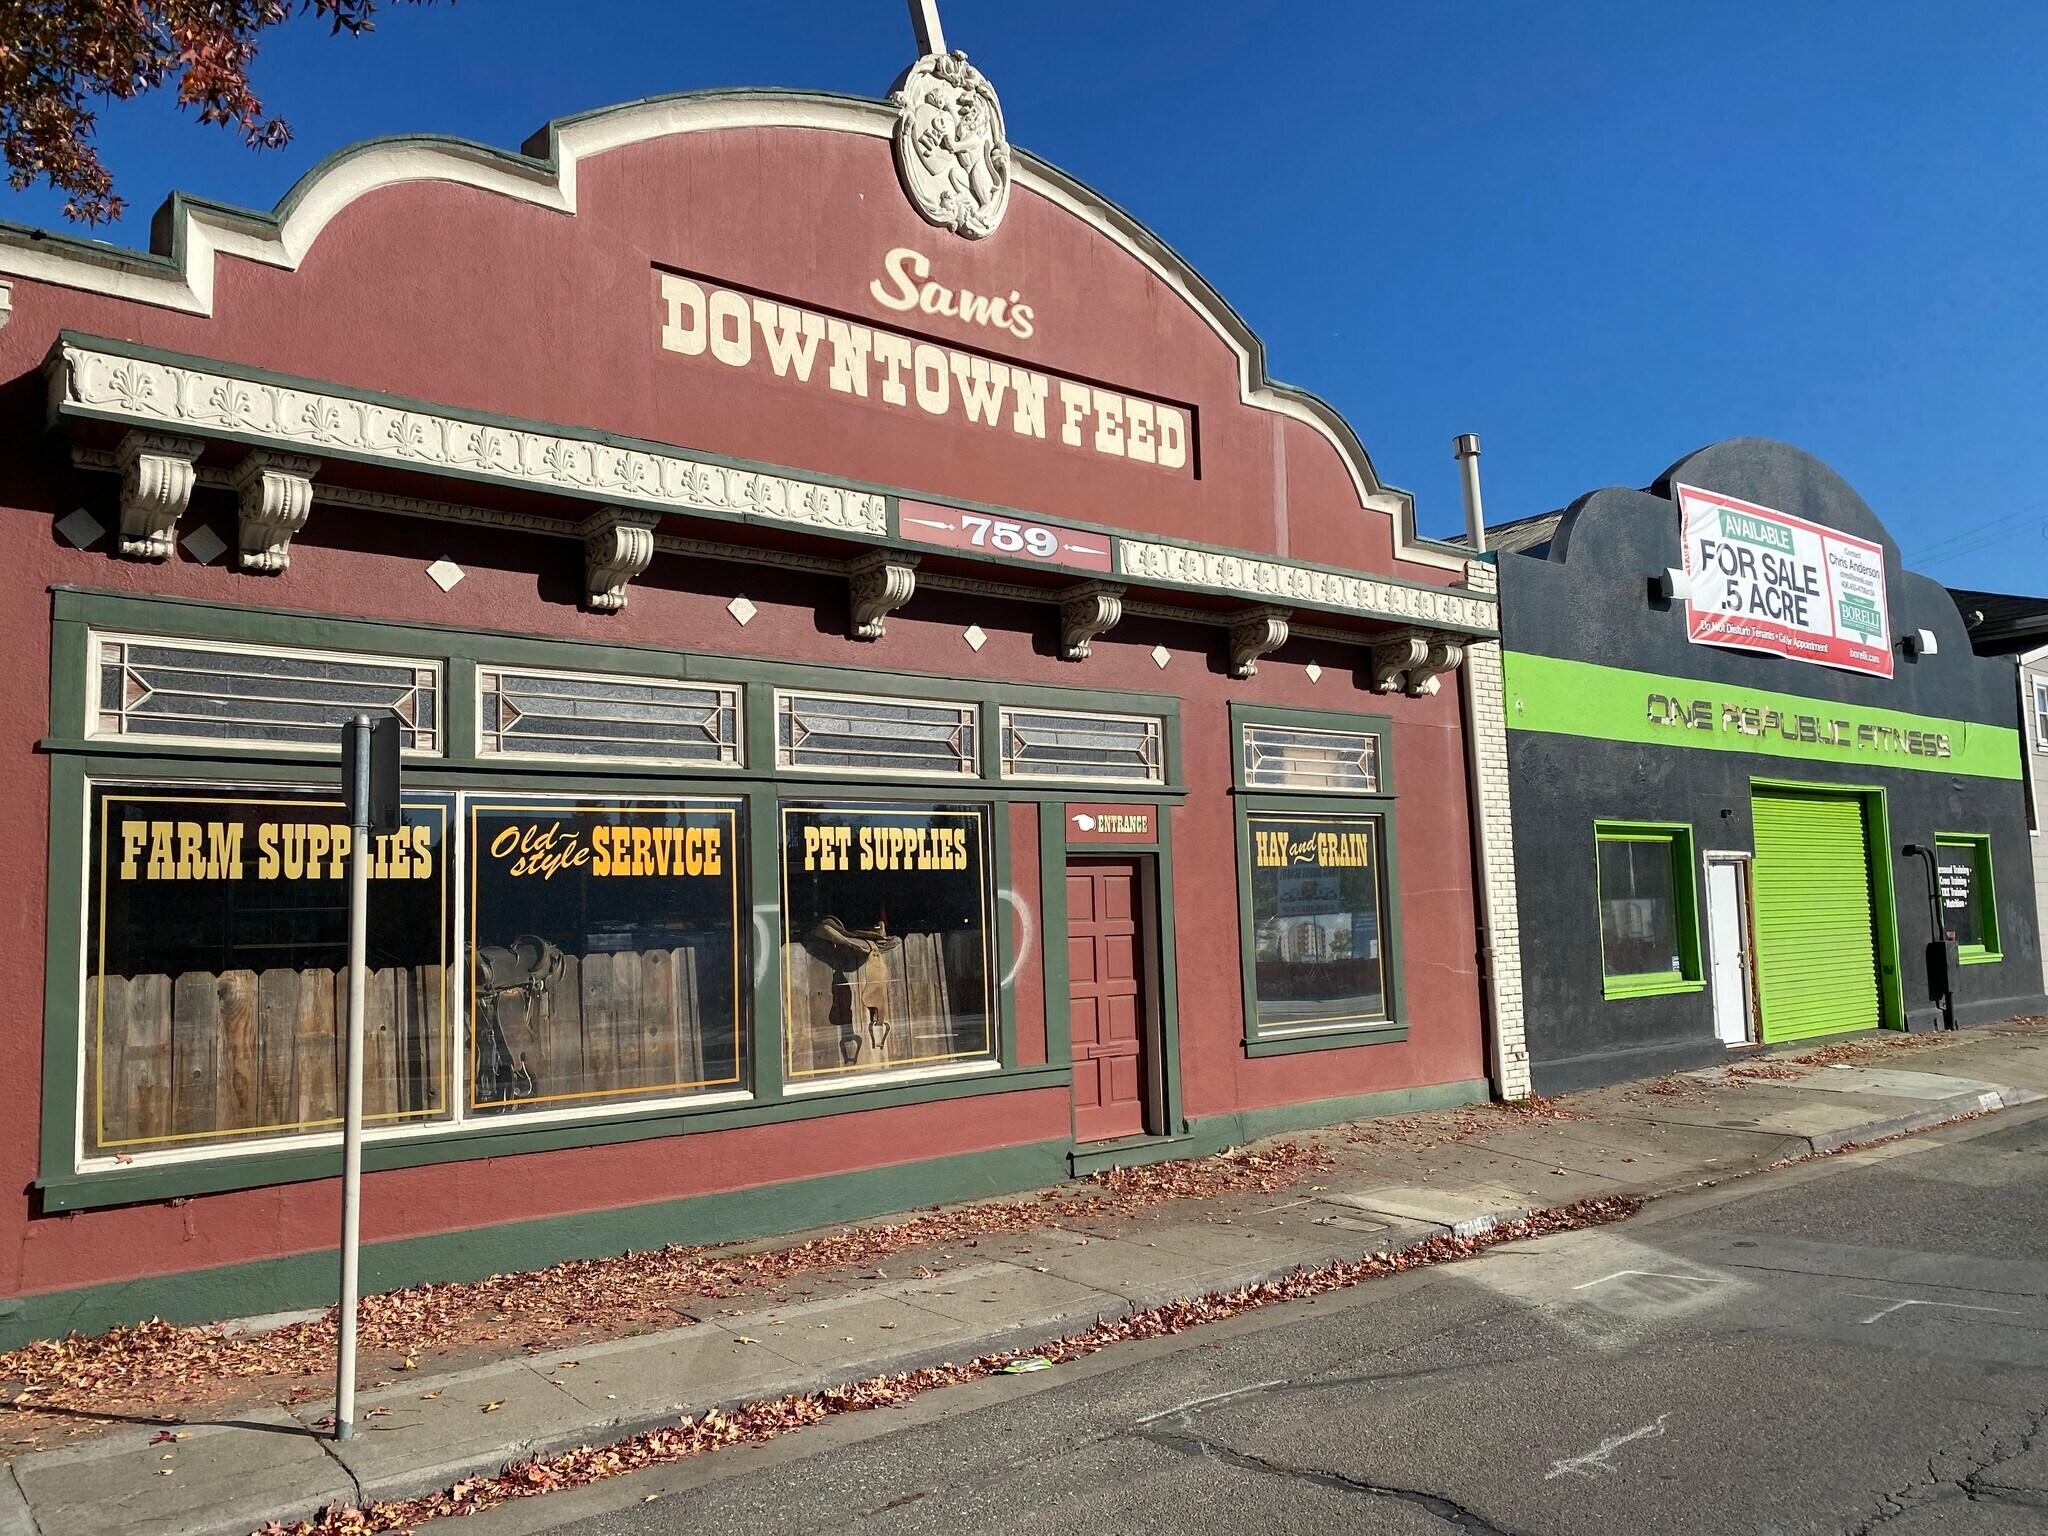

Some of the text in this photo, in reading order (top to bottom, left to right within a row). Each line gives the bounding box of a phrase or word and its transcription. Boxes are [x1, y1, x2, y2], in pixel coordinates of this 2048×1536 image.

[869, 247, 1034, 339] Sam's
[661, 273, 1188, 470] DOWNTOWN FEED
[961, 515, 1058, 557] 759
[1726, 515, 1790, 549] AVAILABLE
[1699, 538, 1758, 581] FOR
[1761, 552, 1820, 598] SALE
[1828, 552, 1880, 579] Chris Anderson
[1721, 578, 1743, 612] .5
[1748, 583, 1810, 628] ACRE
[1842, 605, 1880, 628] BORELLI
[1700, 619, 1711, 631] Do
[1726, 623, 1751, 637] Disturb
[1750, 626, 1776, 641] Tenants
[1793, 637, 1829, 653] Appointment
[1850, 648, 1880, 663] borelli.com
[1647, 693, 1951, 758] ONE REPUBLIC FITNESS
[1097, 814, 1148, 834] ENTRANCE
[120, 820, 433, 880] FARM SUPPIES
[509, 839, 590, 881] style
[592, 825, 722, 877] SERVICE
[804, 826, 968, 871] PET SUPPLIES
[1255, 831, 1368, 867] HAY and GRAIN
